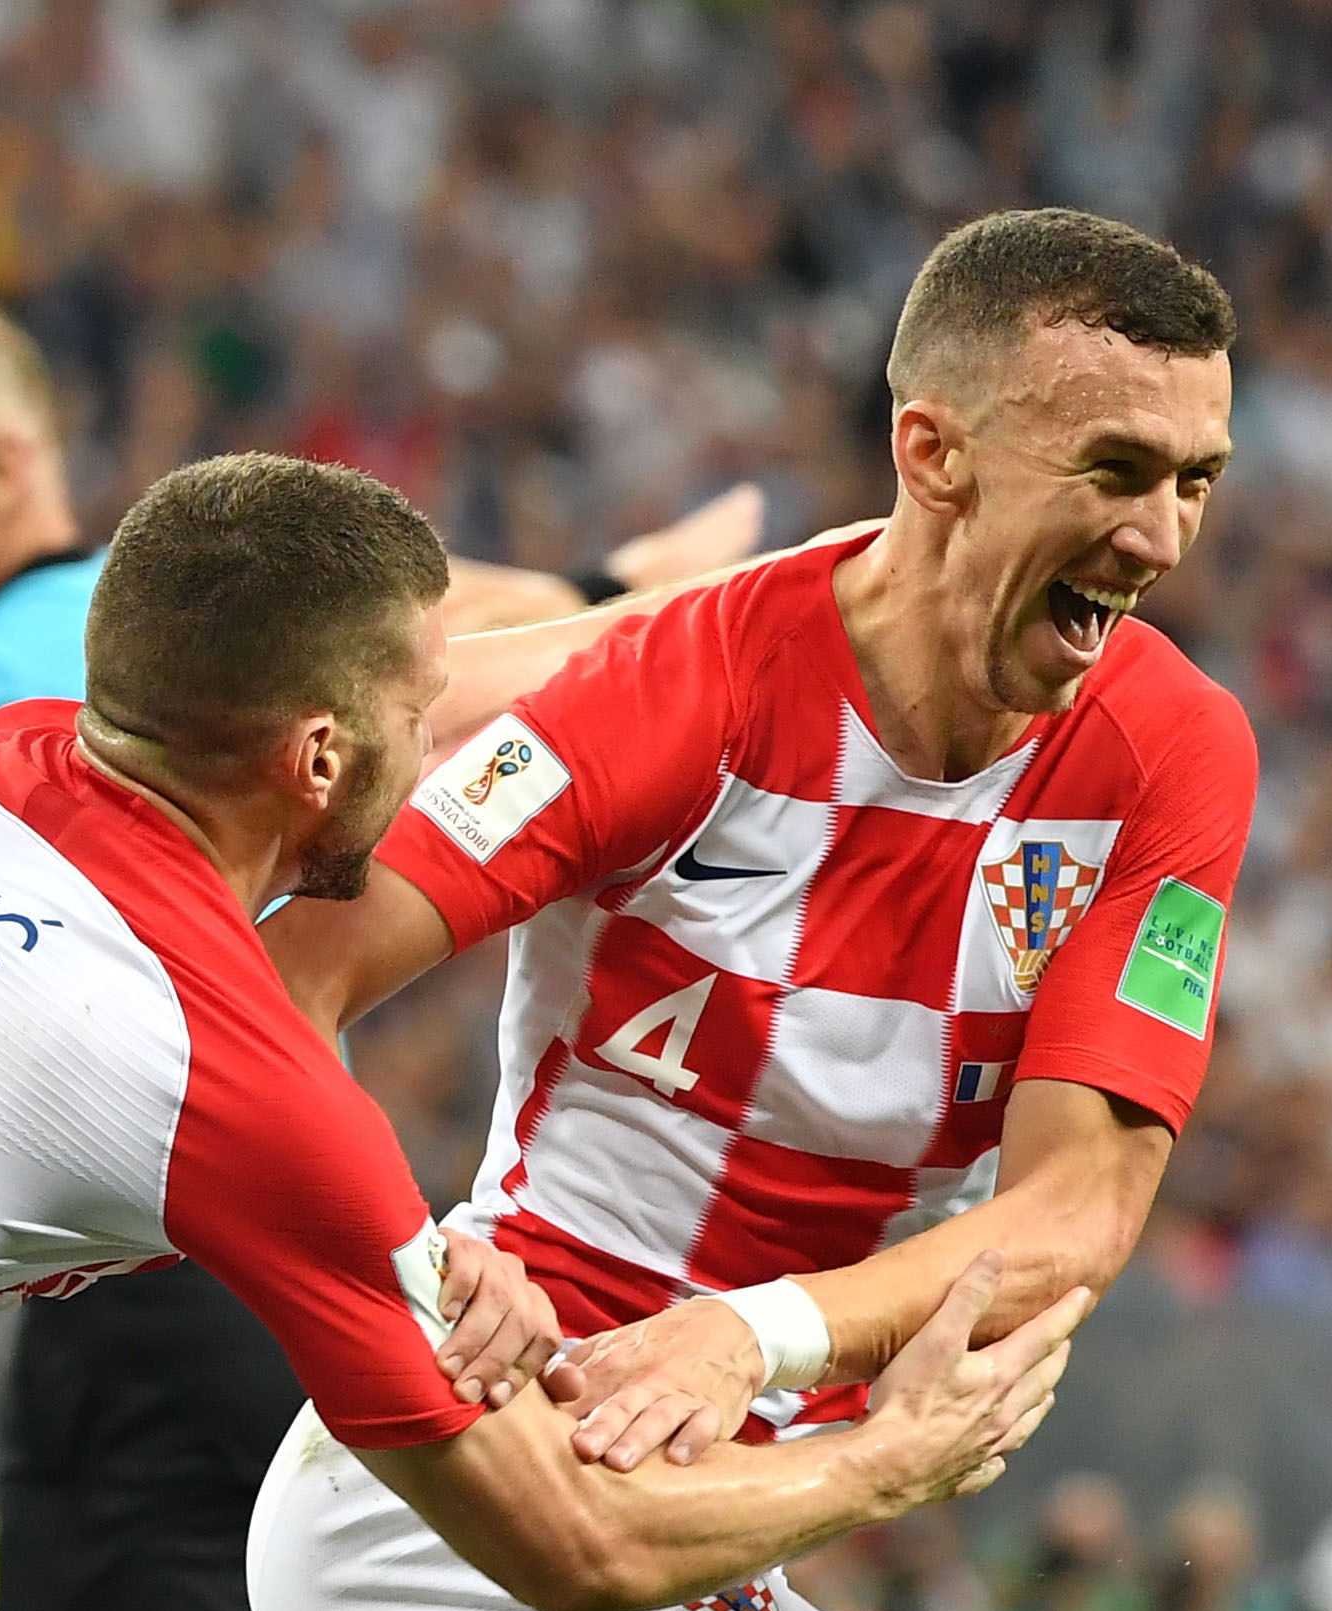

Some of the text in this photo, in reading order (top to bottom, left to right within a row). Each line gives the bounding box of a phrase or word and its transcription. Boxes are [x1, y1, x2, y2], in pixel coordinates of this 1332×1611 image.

[457, 820, 489, 852] 2018
[1031, 854, 1052, 934] HNS
[1182, 976, 1205, 1000] FIFA
[592, 971, 719, 1099] 4
